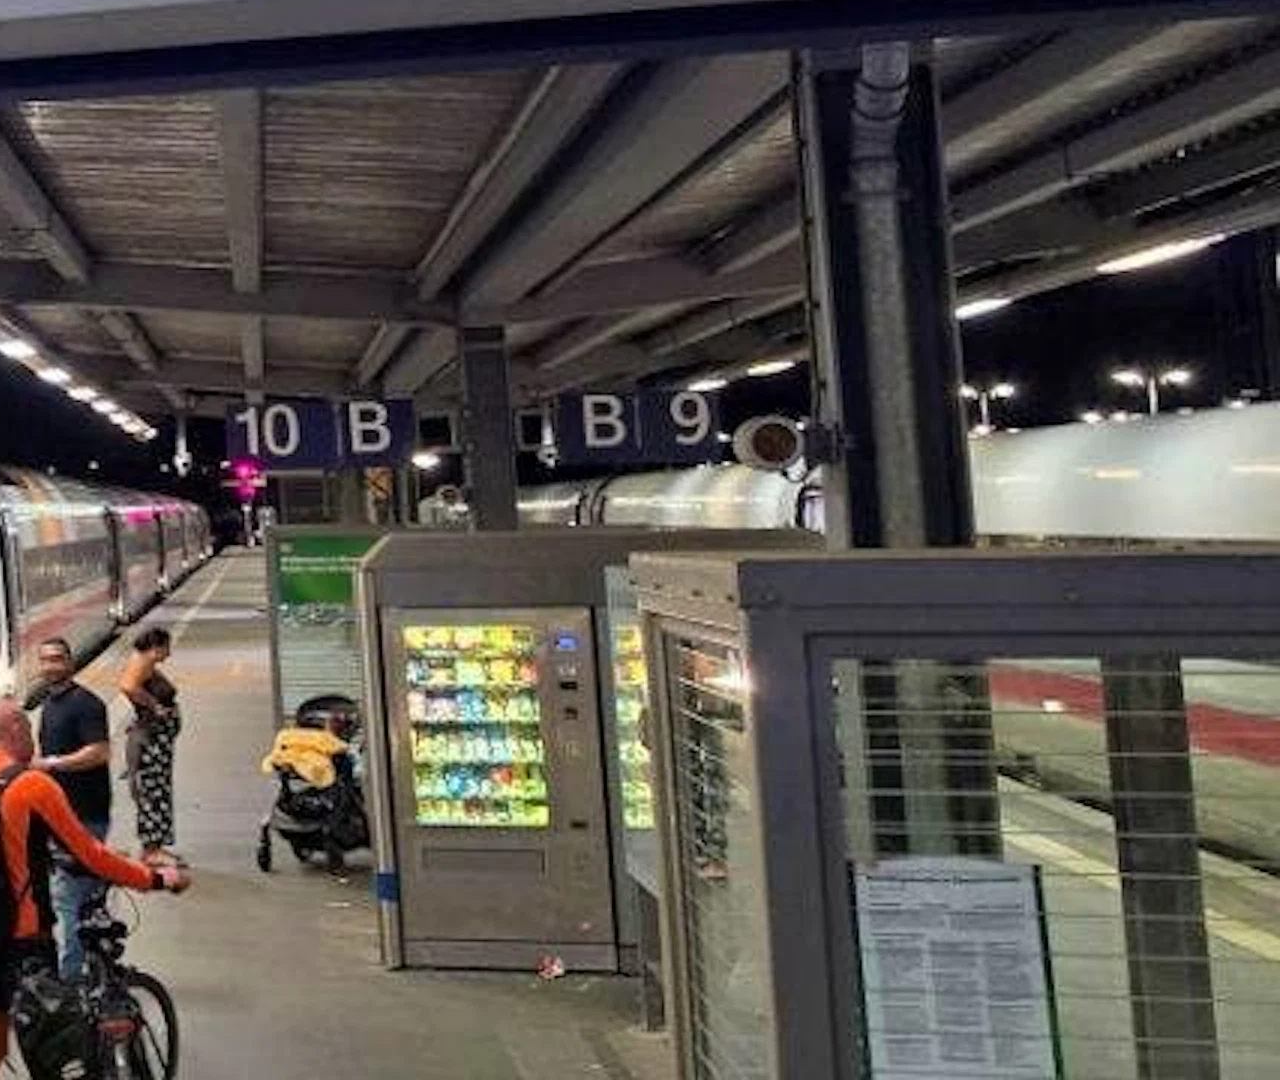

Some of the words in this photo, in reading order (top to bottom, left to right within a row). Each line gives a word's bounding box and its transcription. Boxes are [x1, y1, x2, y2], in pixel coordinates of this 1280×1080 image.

[236, 403, 300, 457] 10
[348, 400, 392, 453] B
[582, 394, 626, 447] B
[669, 391, 710, 446] 9
